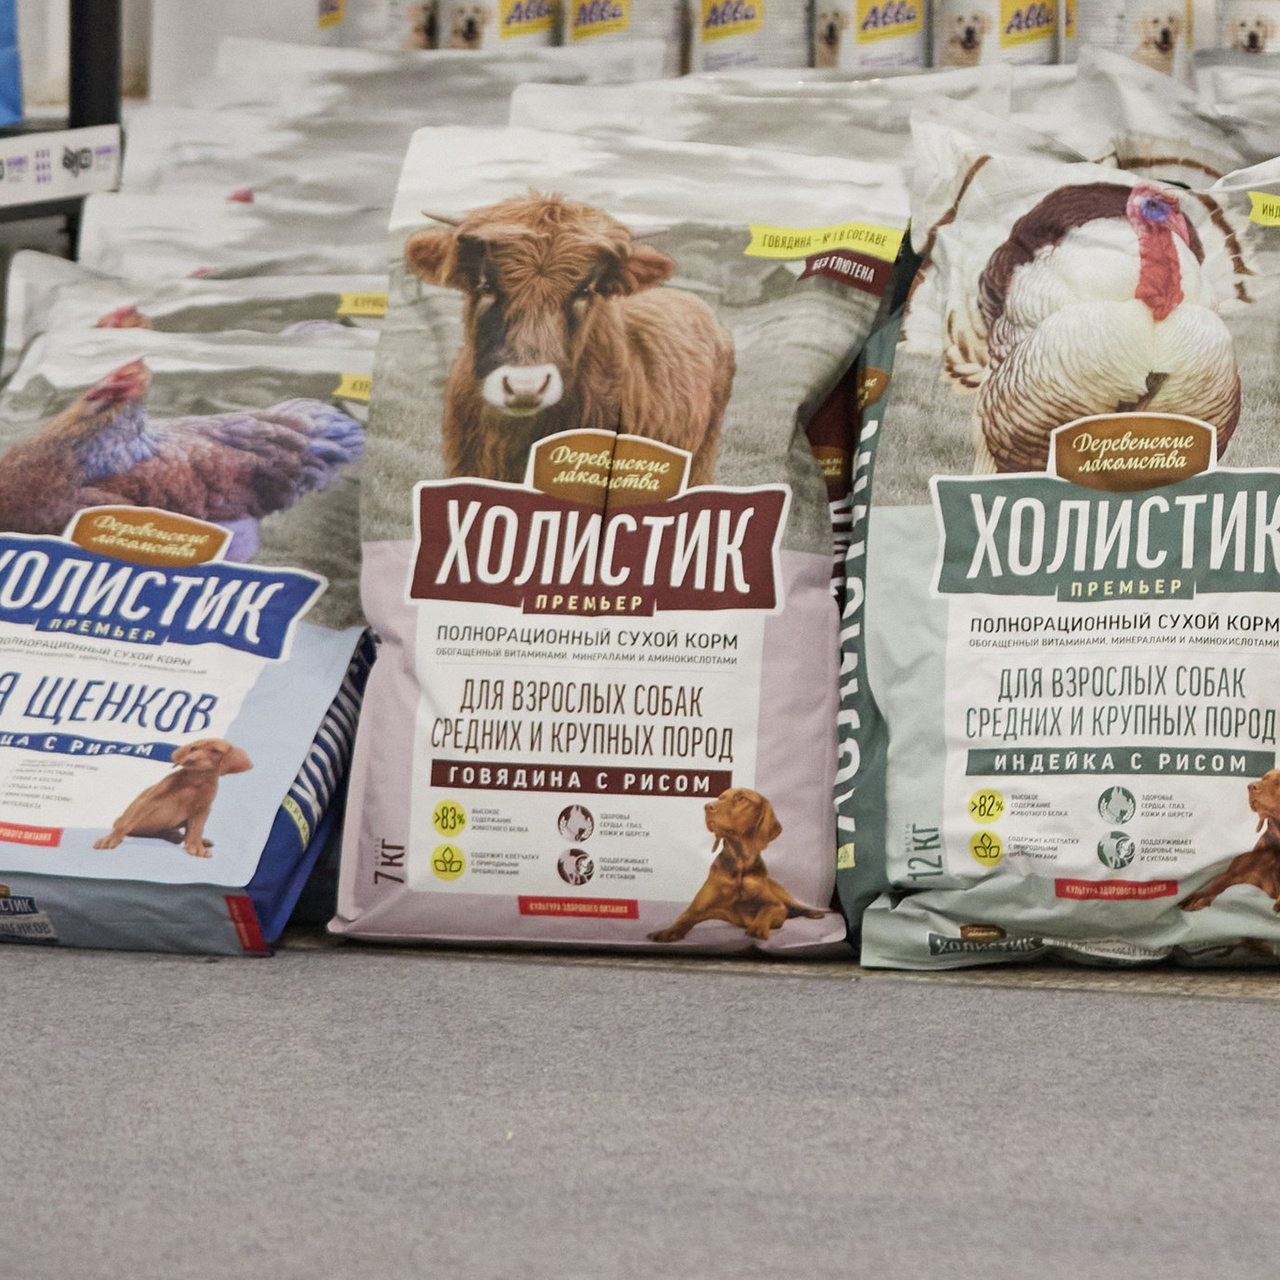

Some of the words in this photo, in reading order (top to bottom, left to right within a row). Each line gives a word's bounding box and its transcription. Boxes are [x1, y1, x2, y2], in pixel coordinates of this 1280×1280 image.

[763, 233, 812, 250] ГОВЯДИНА
[846, 229, 888, 247] СОСТАВЕ
[812, 256, 829, 271] БЕЗ
[829, 255, 876, 283] ГЛЮТЕНА
[1072, 431, 1195, 458] Деревенские
[1078, 453, 1188, 474] лакомства
[435, 499, 755, 595] ХОЛИСТИК
[1070, 578, 1184, 598] ПРЕМЬЕР
[534, 594, 644, 612] ПРЕМЬЕР
[49, 618, 156, 643] ПРЕМЬЕР
[970, 612, 1152, 635] ПОЛНОРАЦИОННЫЙ
[1158, 611, 1220, 631] СУХОЙ
[1226, 615, 1280, 633] КОРМ
[437, 625, 611, 647] ПОЛНОРАЦИОННЫЙ
[617, 629, 678, 648] СУХОЙ
[686, 634, 738, 650] КОРМ
[1111, 636, 1177, 646] МИНЕРАЛАМИ
[1179, 637, 1186, 646] И
[114, 648, 154, 662] СУХОЙ
[156, 655, 193, 667] КОРМ
[997, 667, 1043, 702] ДЛЯ
[1052, 666, 1167, 698] ВЗРОСЛЫХ
[1175, 667, 1247, 699] СОБАК
[24, 675, 219, 734] ЩЕНКОВ
[460, 678, 505, 713] ДЛЯ
[512, 680, 627, 715] ВЗРОСЛЫХ
[633, 683, 704, 718] СОБАК
[966, 707, 1063, 741] СРЕДНИХ
[1070, 706, 1084, 736] И
[1093, 705, 1197, 737] КРУПНЫХ
[1205, 707, 1277, 745] ПОРОД
[69, 742, 155, 757] РИСОМ
[431, 717, 523, 754] СРЕДНИХ
[529, 721, 543, 753] И
[551, 722, 655, 757] КРУПНЫХ
[662, 725, 734, 763] ПОРОД
[994, 750, 1116, 773] ИНДЕЙКА
[1130, 753, 1143, 770] С
[1159, 754, 1248, 773] РИСОМ
[450, 766, 581, 789] ГОВЯДИНА
[596, 773, 609, 790] С
[624, 773, 711, 793] РИСОМ
[434, 806, 466, 830] >83%
[971, 794, 1004, 817] >82%
[912, 823, 942, 851] КГ
[380, 837, 406, 868] КГ
[373, 870, 405, 885] 7
[907, 854, 943, 881] 12
